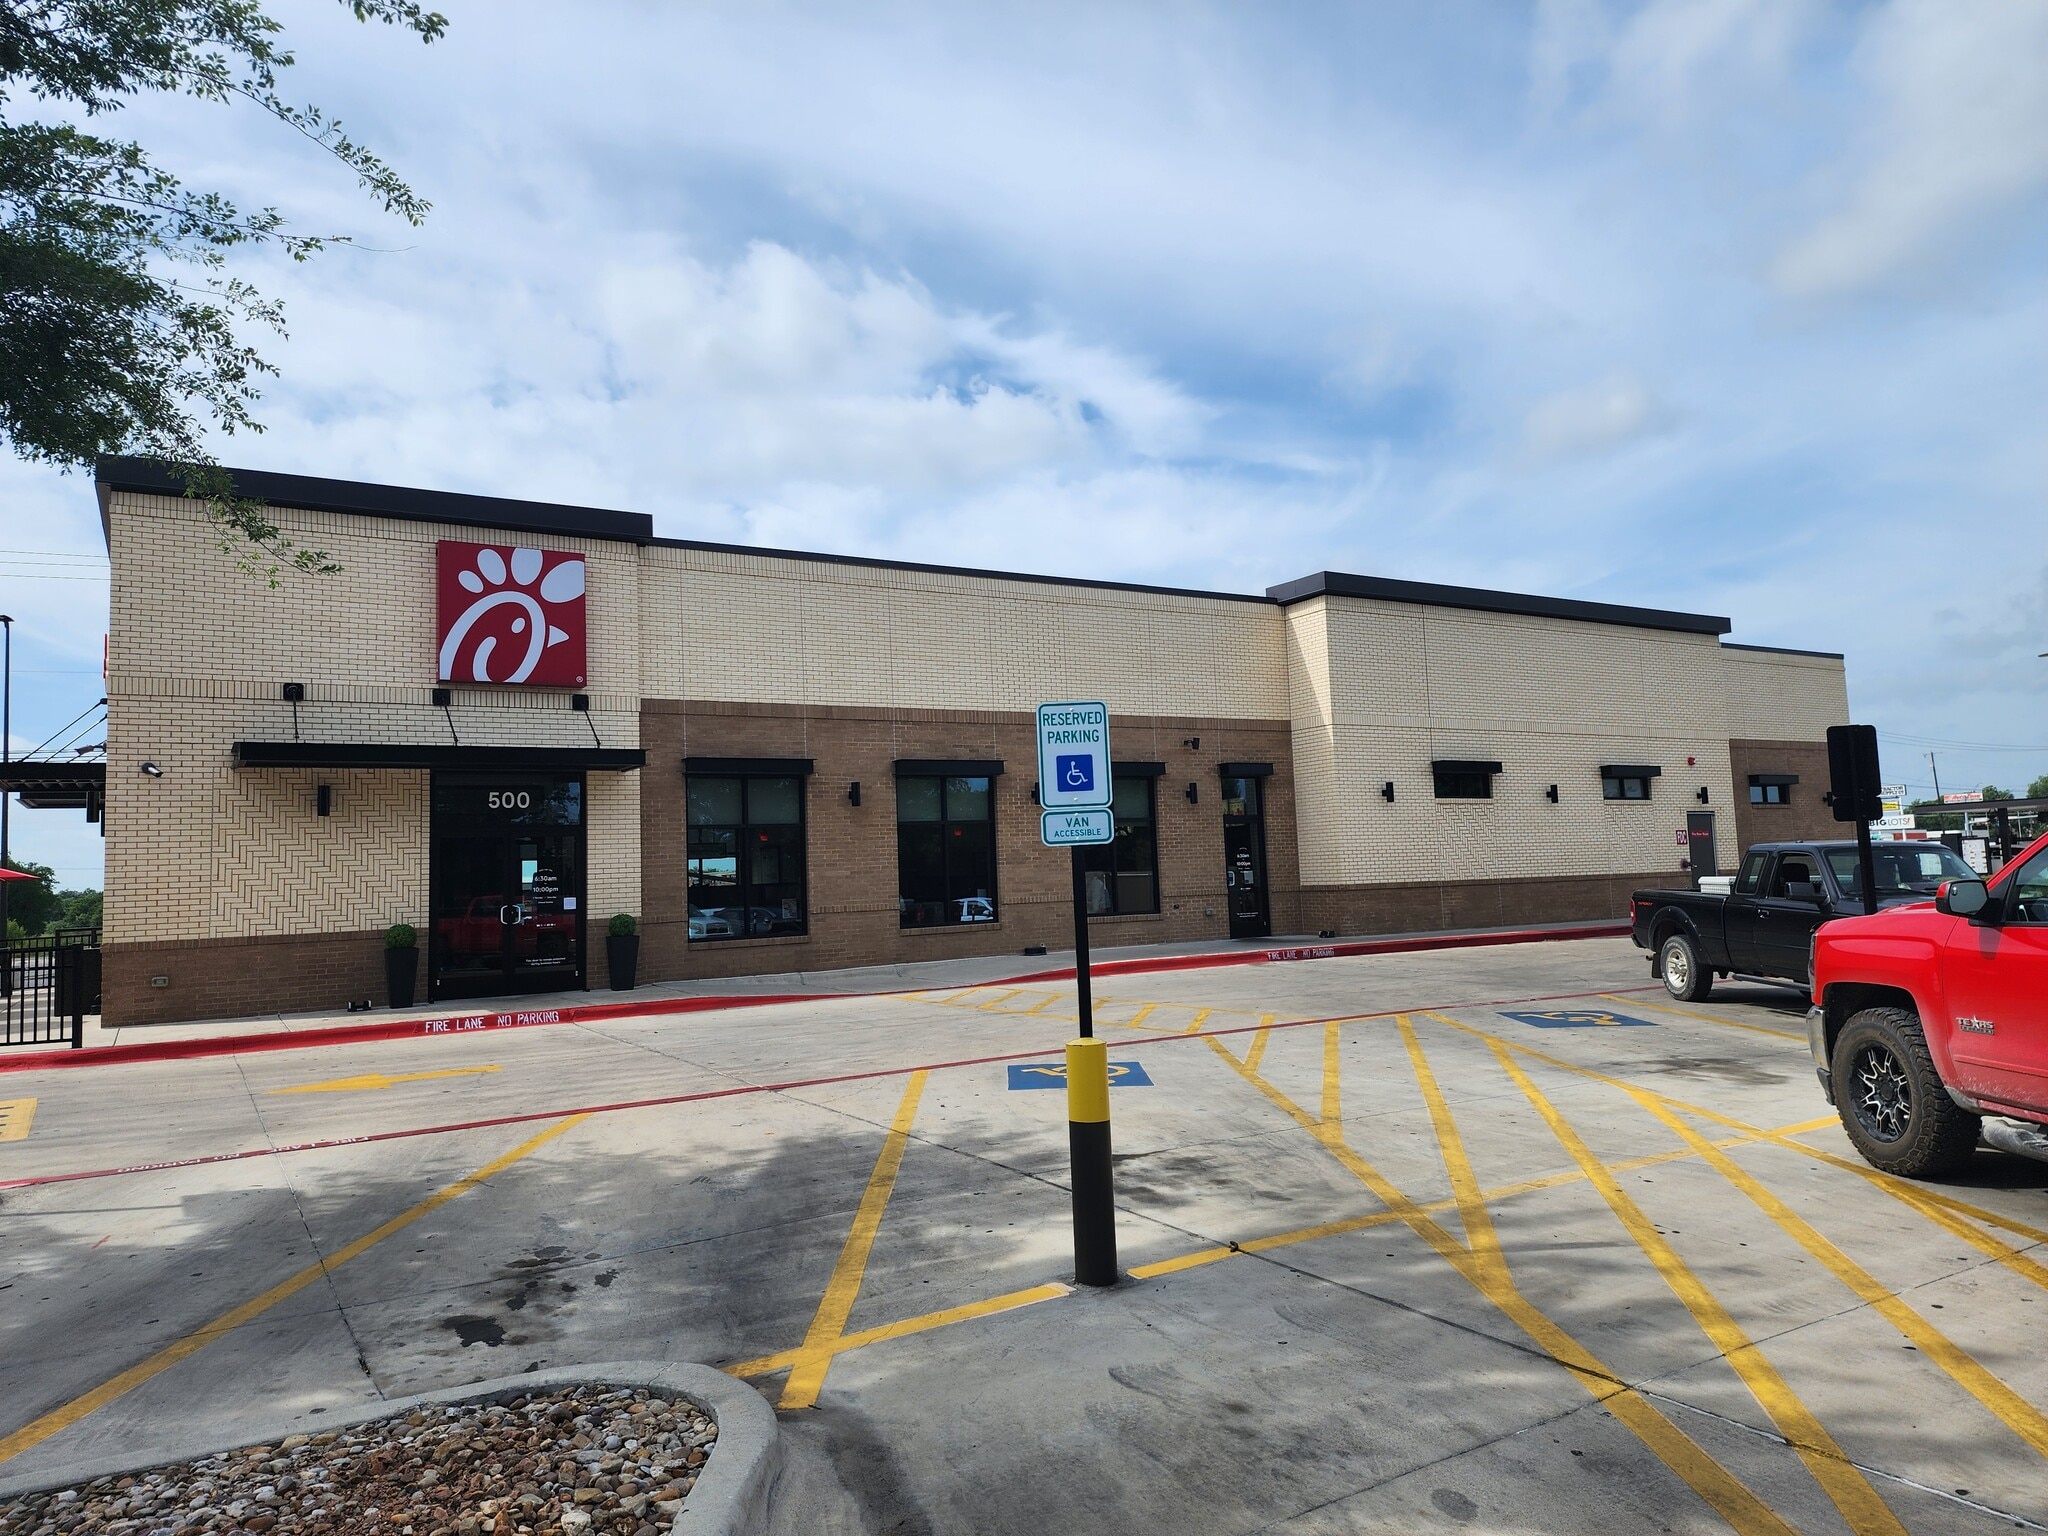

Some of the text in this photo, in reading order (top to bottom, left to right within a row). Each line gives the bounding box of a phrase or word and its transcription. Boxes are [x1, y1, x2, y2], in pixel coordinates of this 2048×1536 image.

[1042, 711, 1103, 727] RESERVED
[1047, 729, 1100, 744] PARKING
[488, 791, 530, 809] 500
[1065, 817, 1090, 828] VAN
[1888, 817, 1911, 826] LOTS!
[1054, 828, 1102, 838] ACCESSIBLE
[1676, 830, 1687, 844] FDC
[1267, 951, 1281, 960] FIRE
[1282, 950, 1298, 960] LANE
[1312, 947, 1335, 957] PARKING
[425, 1011, 559, 1033] FIRE LANE NO PARKING
[118, 1159, 201, 1173] PARKING
